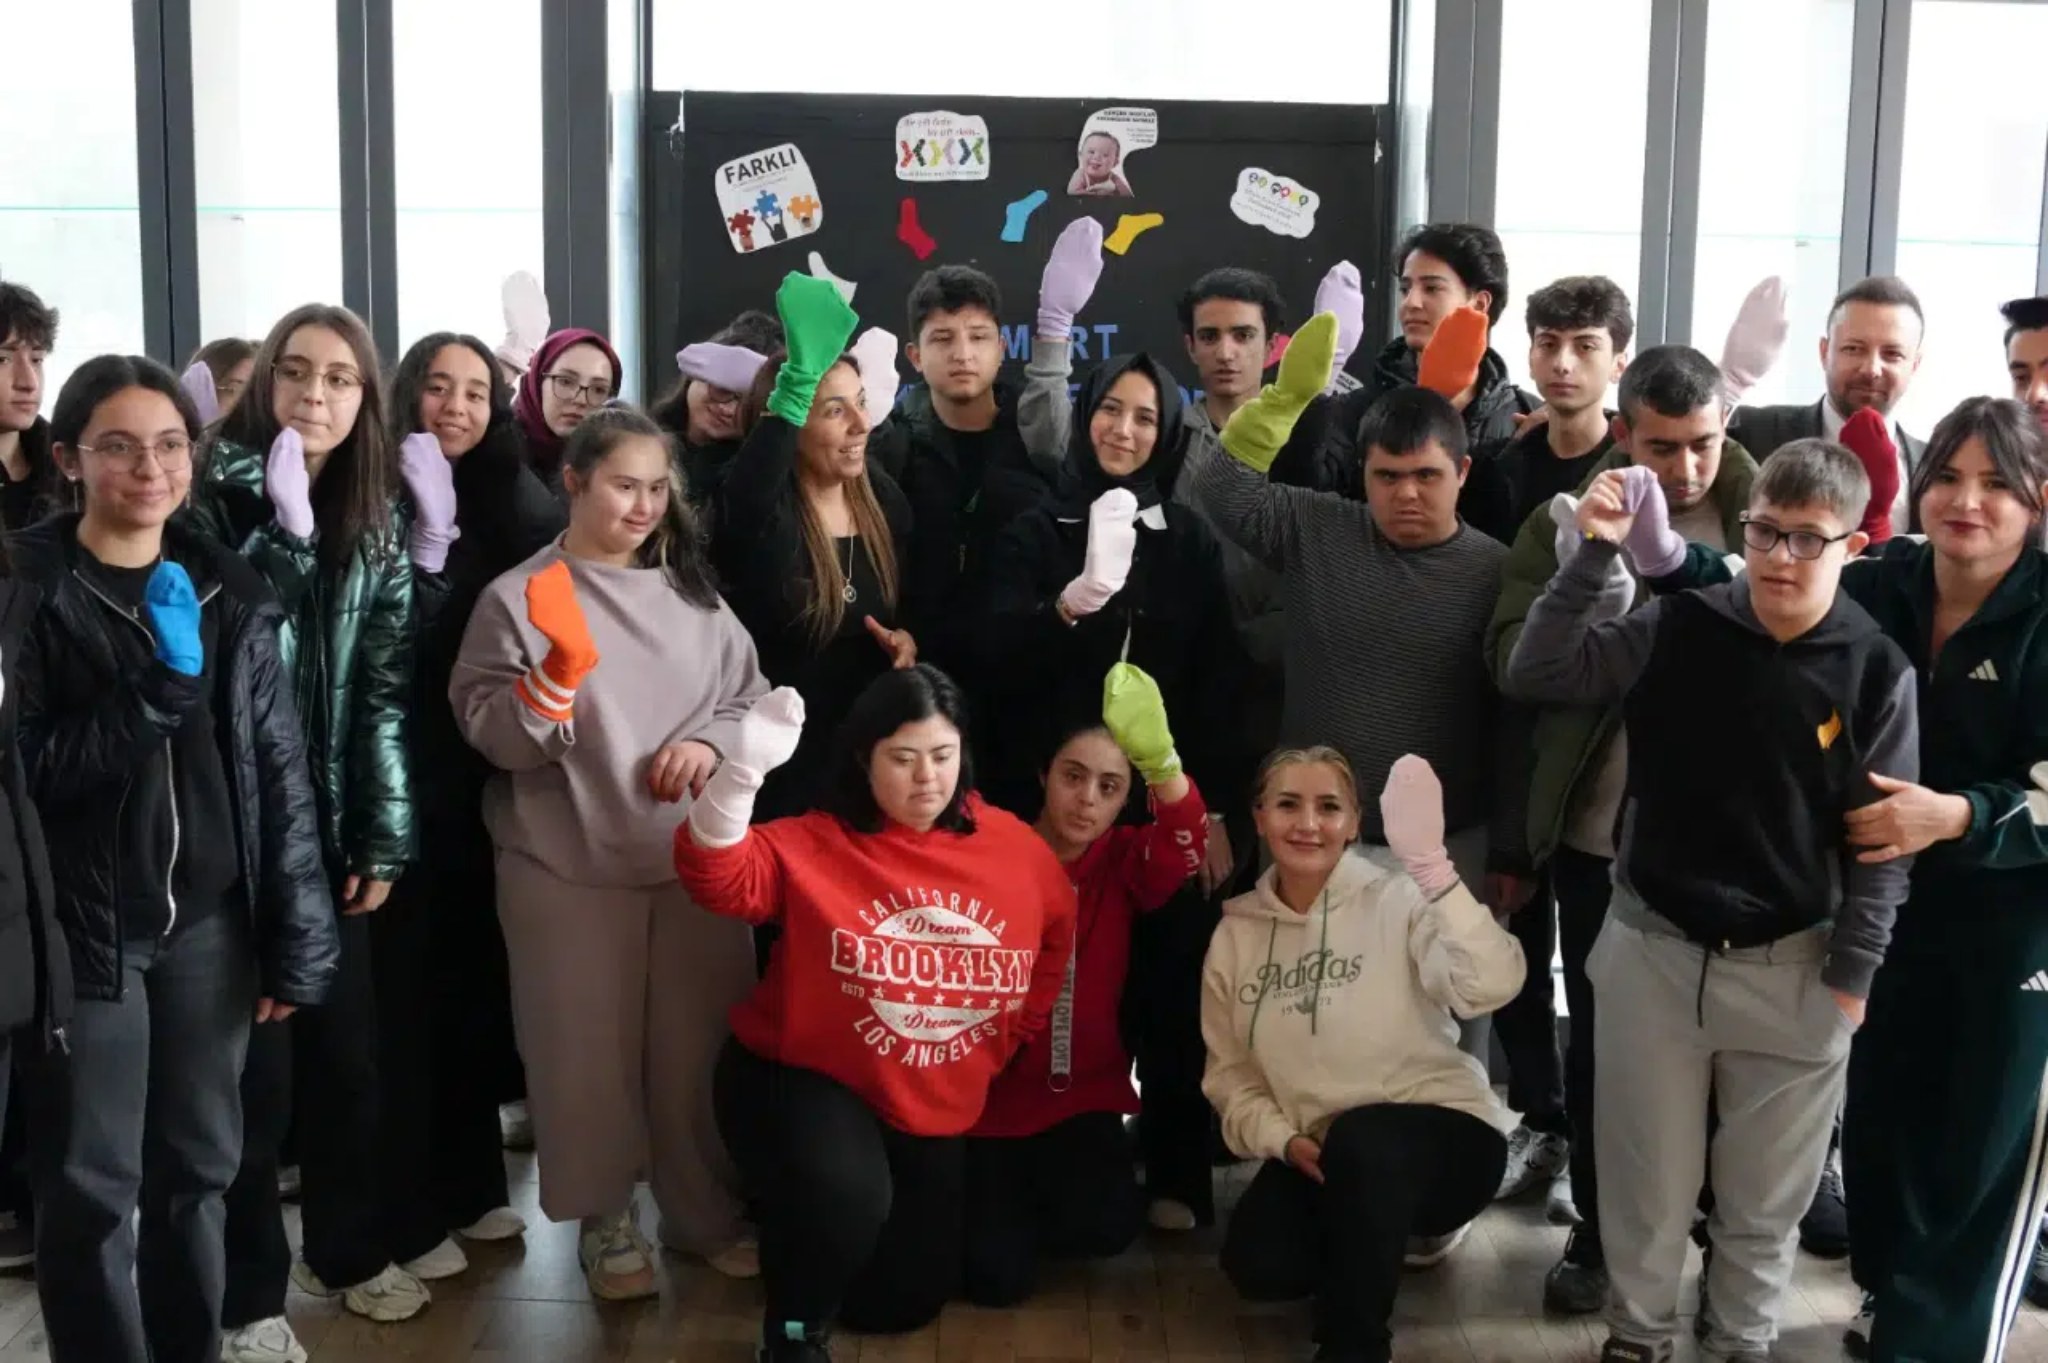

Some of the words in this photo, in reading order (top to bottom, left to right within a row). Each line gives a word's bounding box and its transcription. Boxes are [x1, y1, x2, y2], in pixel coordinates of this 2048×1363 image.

[724, 147, 798, 185] FARKLI
[1001, 324, 1119, 361] MRT
[858, 887, 1007, 937] CALIFORNIA
[904, 916, 976, 936] Dream
[831, 927, 1033, 993] BROOKLYN
[1239, 948, 1364, 1006] Adidas
[853, 1015, 897, 1056] LOS
[901, 1021, 998, 1069] ANGELES
[903, 1011, 967, 1030] Dream
